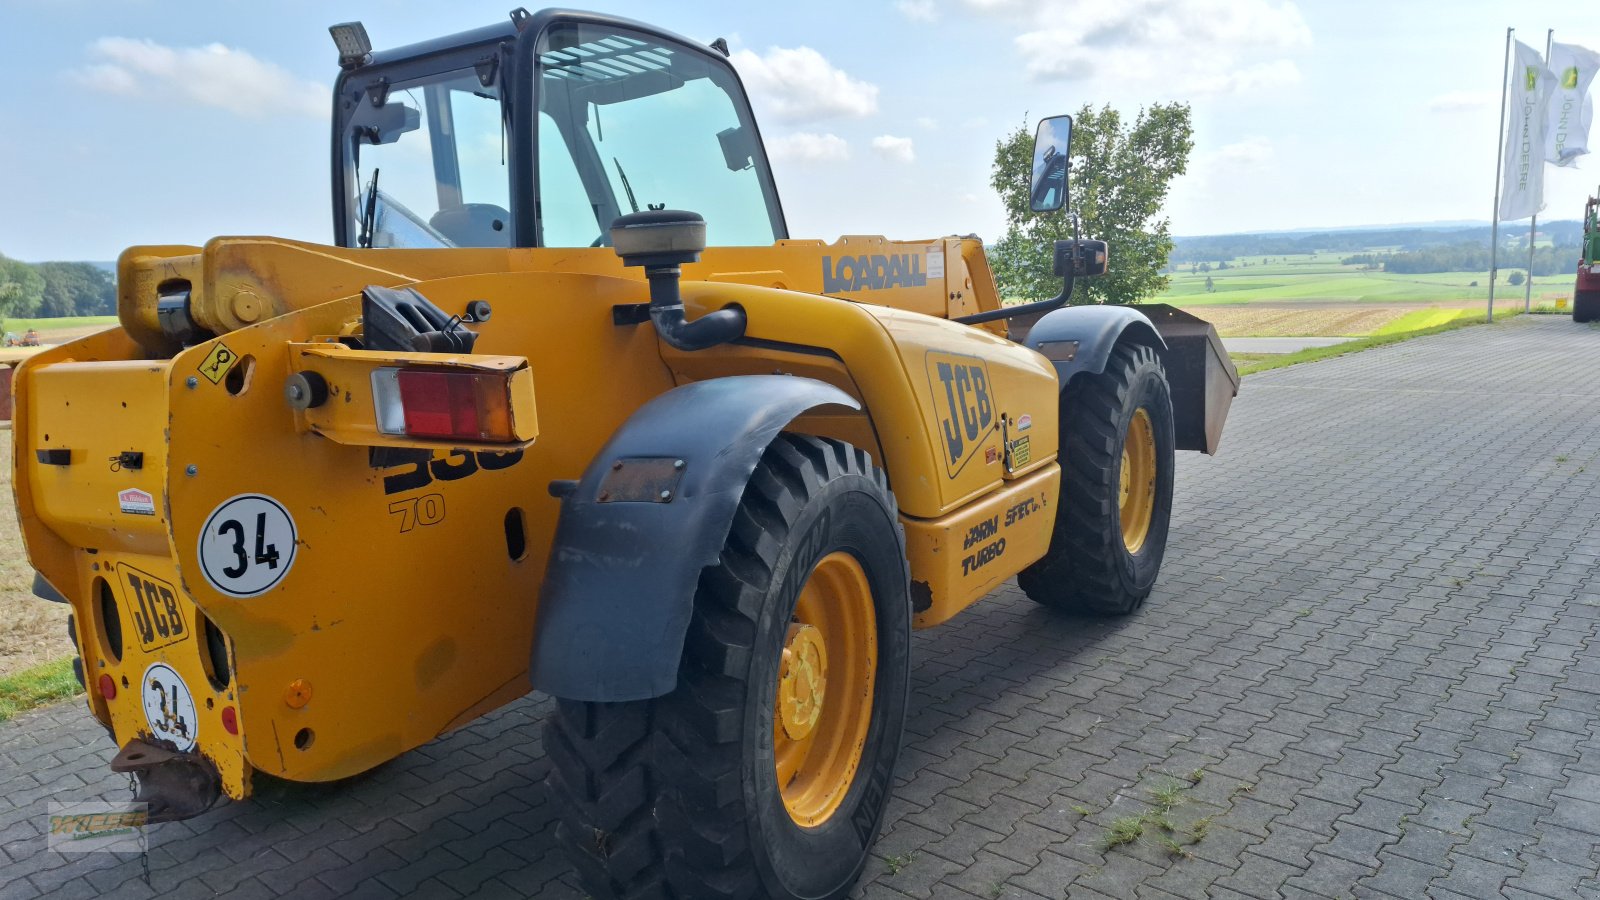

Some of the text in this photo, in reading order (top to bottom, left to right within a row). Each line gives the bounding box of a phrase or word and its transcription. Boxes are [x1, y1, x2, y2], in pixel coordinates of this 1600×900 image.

[1558, 95, 1575, 130] JOHN
[1519, 98, 1535, 190] JOHN DEERE
[822, 254, 927, 294] LOADALL
[936, 361, 992, 466] JCB
[389, 493, 446, 534] 70
[218, 511, 280, 579] 34
[962, 537, 1006, 577] TURBO
[128, 572, 183, 644] JCB
[151, 680, 190, 741] 34
